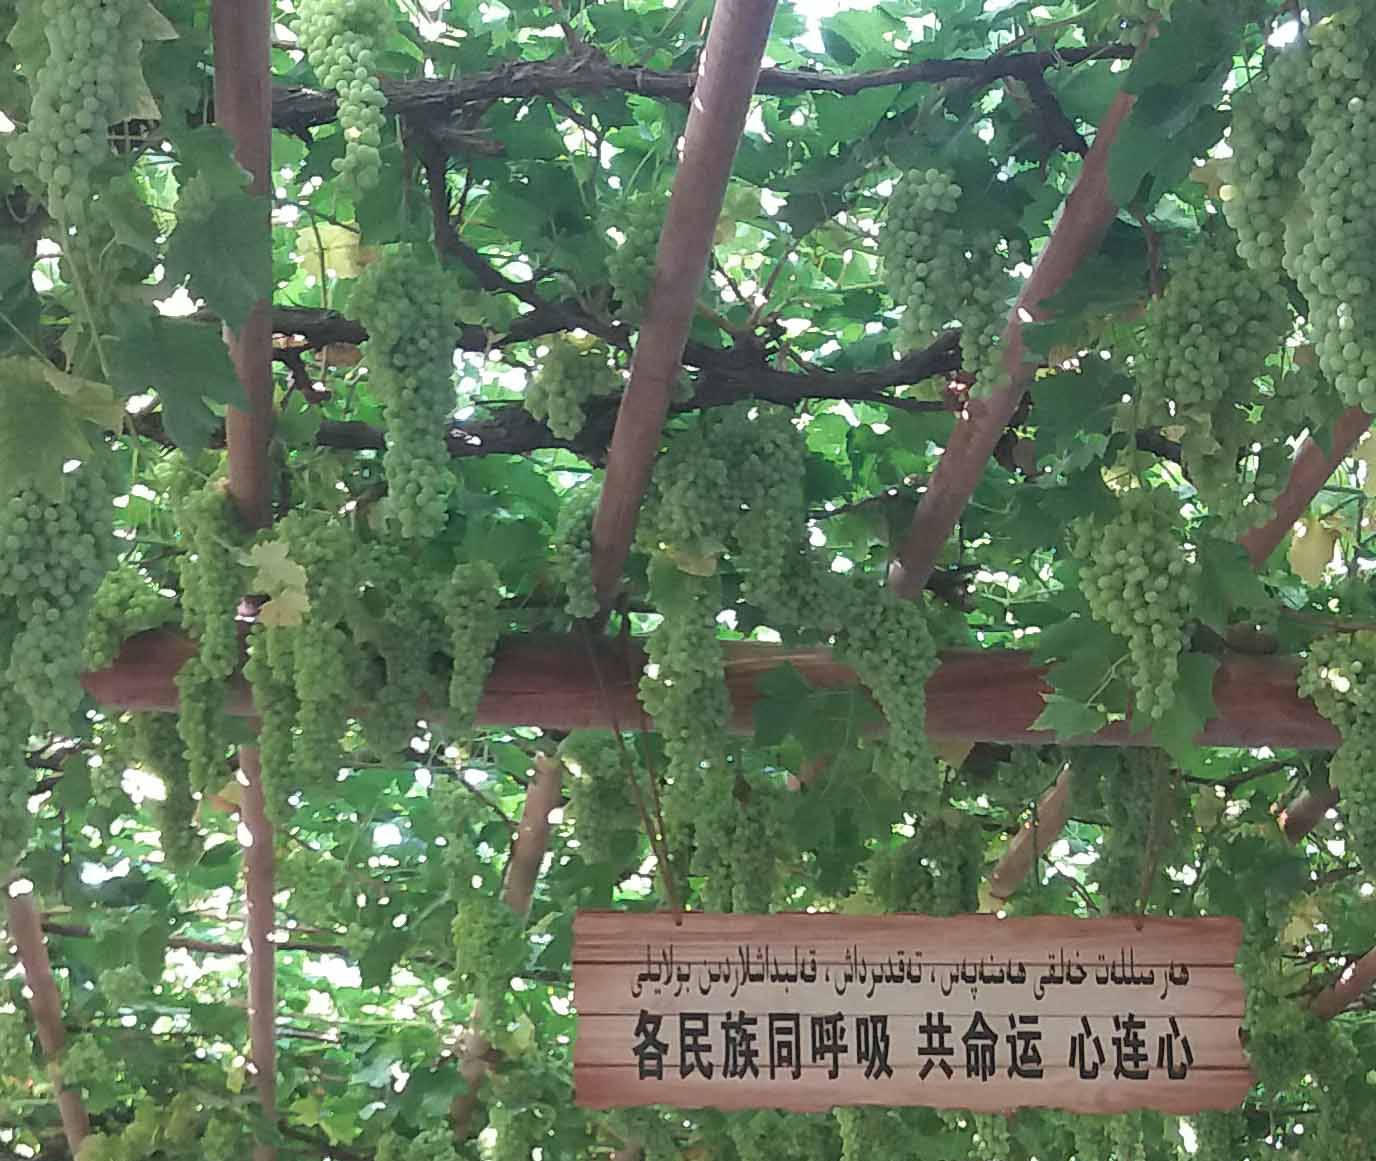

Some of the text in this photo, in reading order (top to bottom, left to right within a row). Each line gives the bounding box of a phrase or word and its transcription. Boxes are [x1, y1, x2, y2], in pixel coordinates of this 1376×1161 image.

[632, 1008, 1195, 1082] 各民族同呼吸 共命运 心连心
